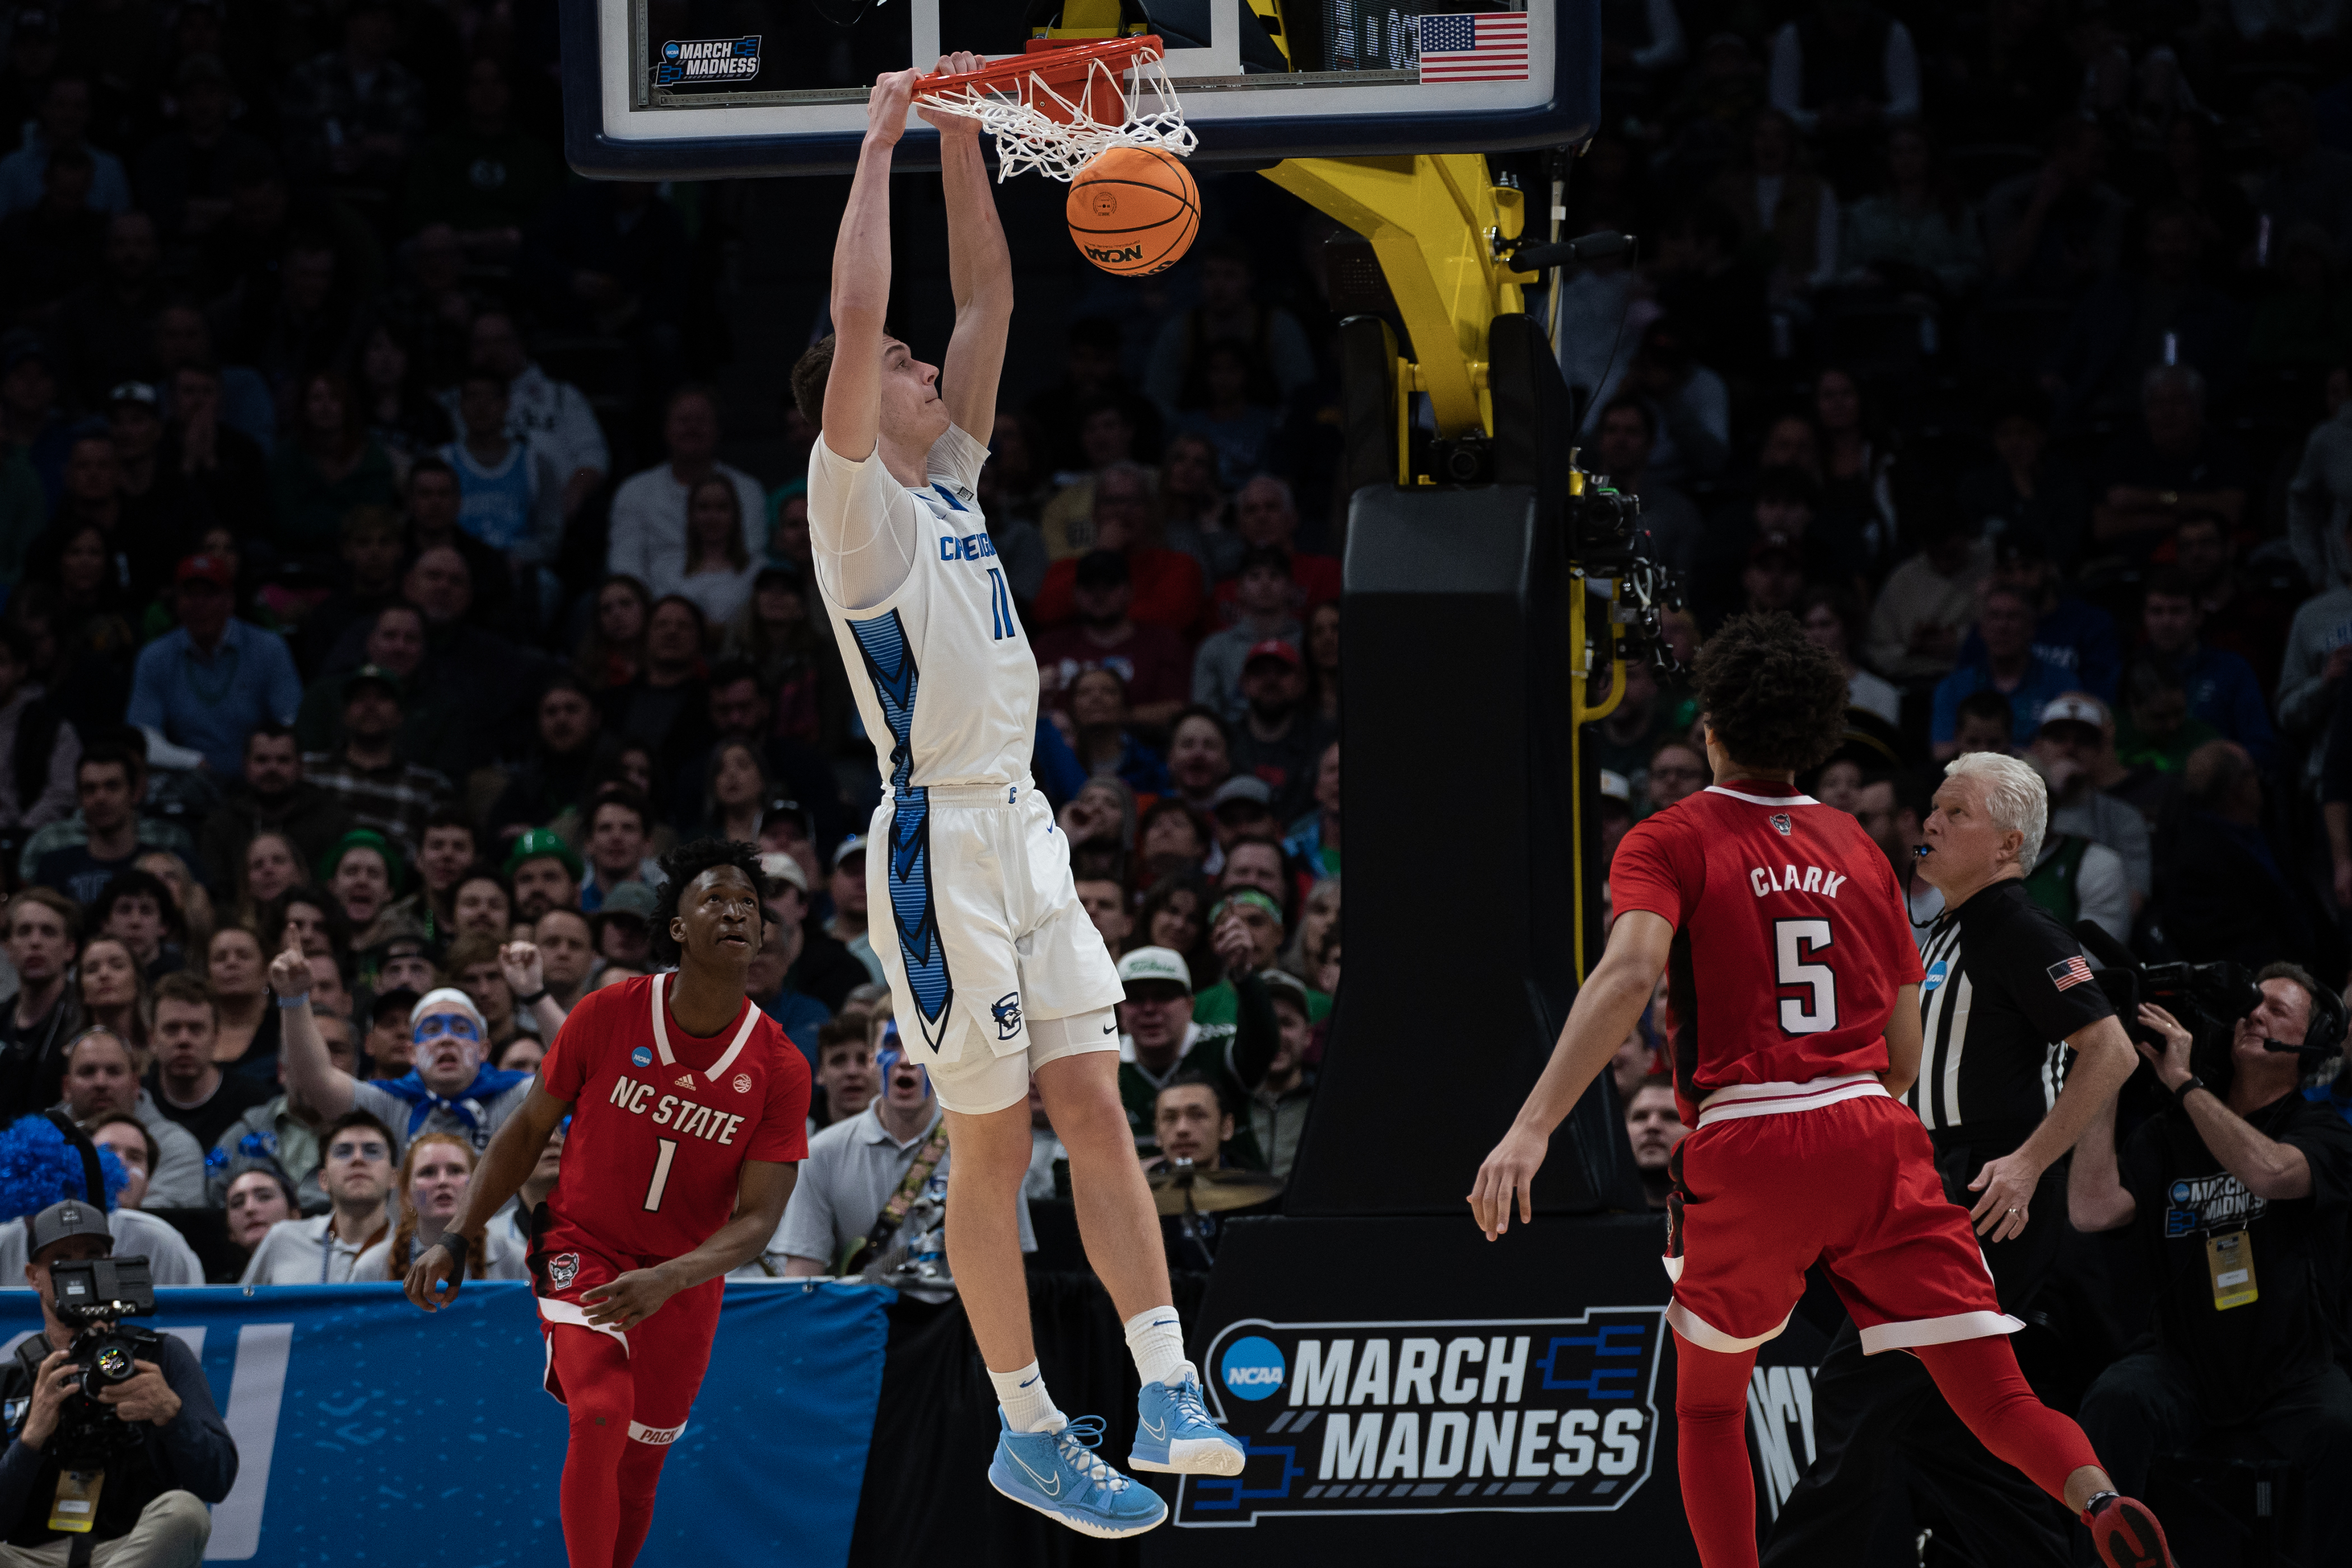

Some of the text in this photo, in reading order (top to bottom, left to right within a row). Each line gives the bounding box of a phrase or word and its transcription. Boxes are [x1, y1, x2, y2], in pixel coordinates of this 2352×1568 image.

[680, 42, 732, 59] MARCH
[686, 57, 757, 75] MADNESS
[1084, 244, 1143, 263] NCAA
[986, 568, 1016, 640] 11
[1008, 787, 1016, 804] C
[1750, 864, 1847, 898] CLARK
[1772, 917, 1840, 1037] 5
[674, 1080, 697, 1091] adidas
[609, 1075, 745, 1145] NC STATE
[642, 1135, 679, 1213] 1
[1228, 1366, 1284, 1385] NCAA
[1288, 1336, 1531, 1406] MARCH
[640, 1429, 679, 1443] PACK
[1318, 1408, 1644, 1480] MADNESS
